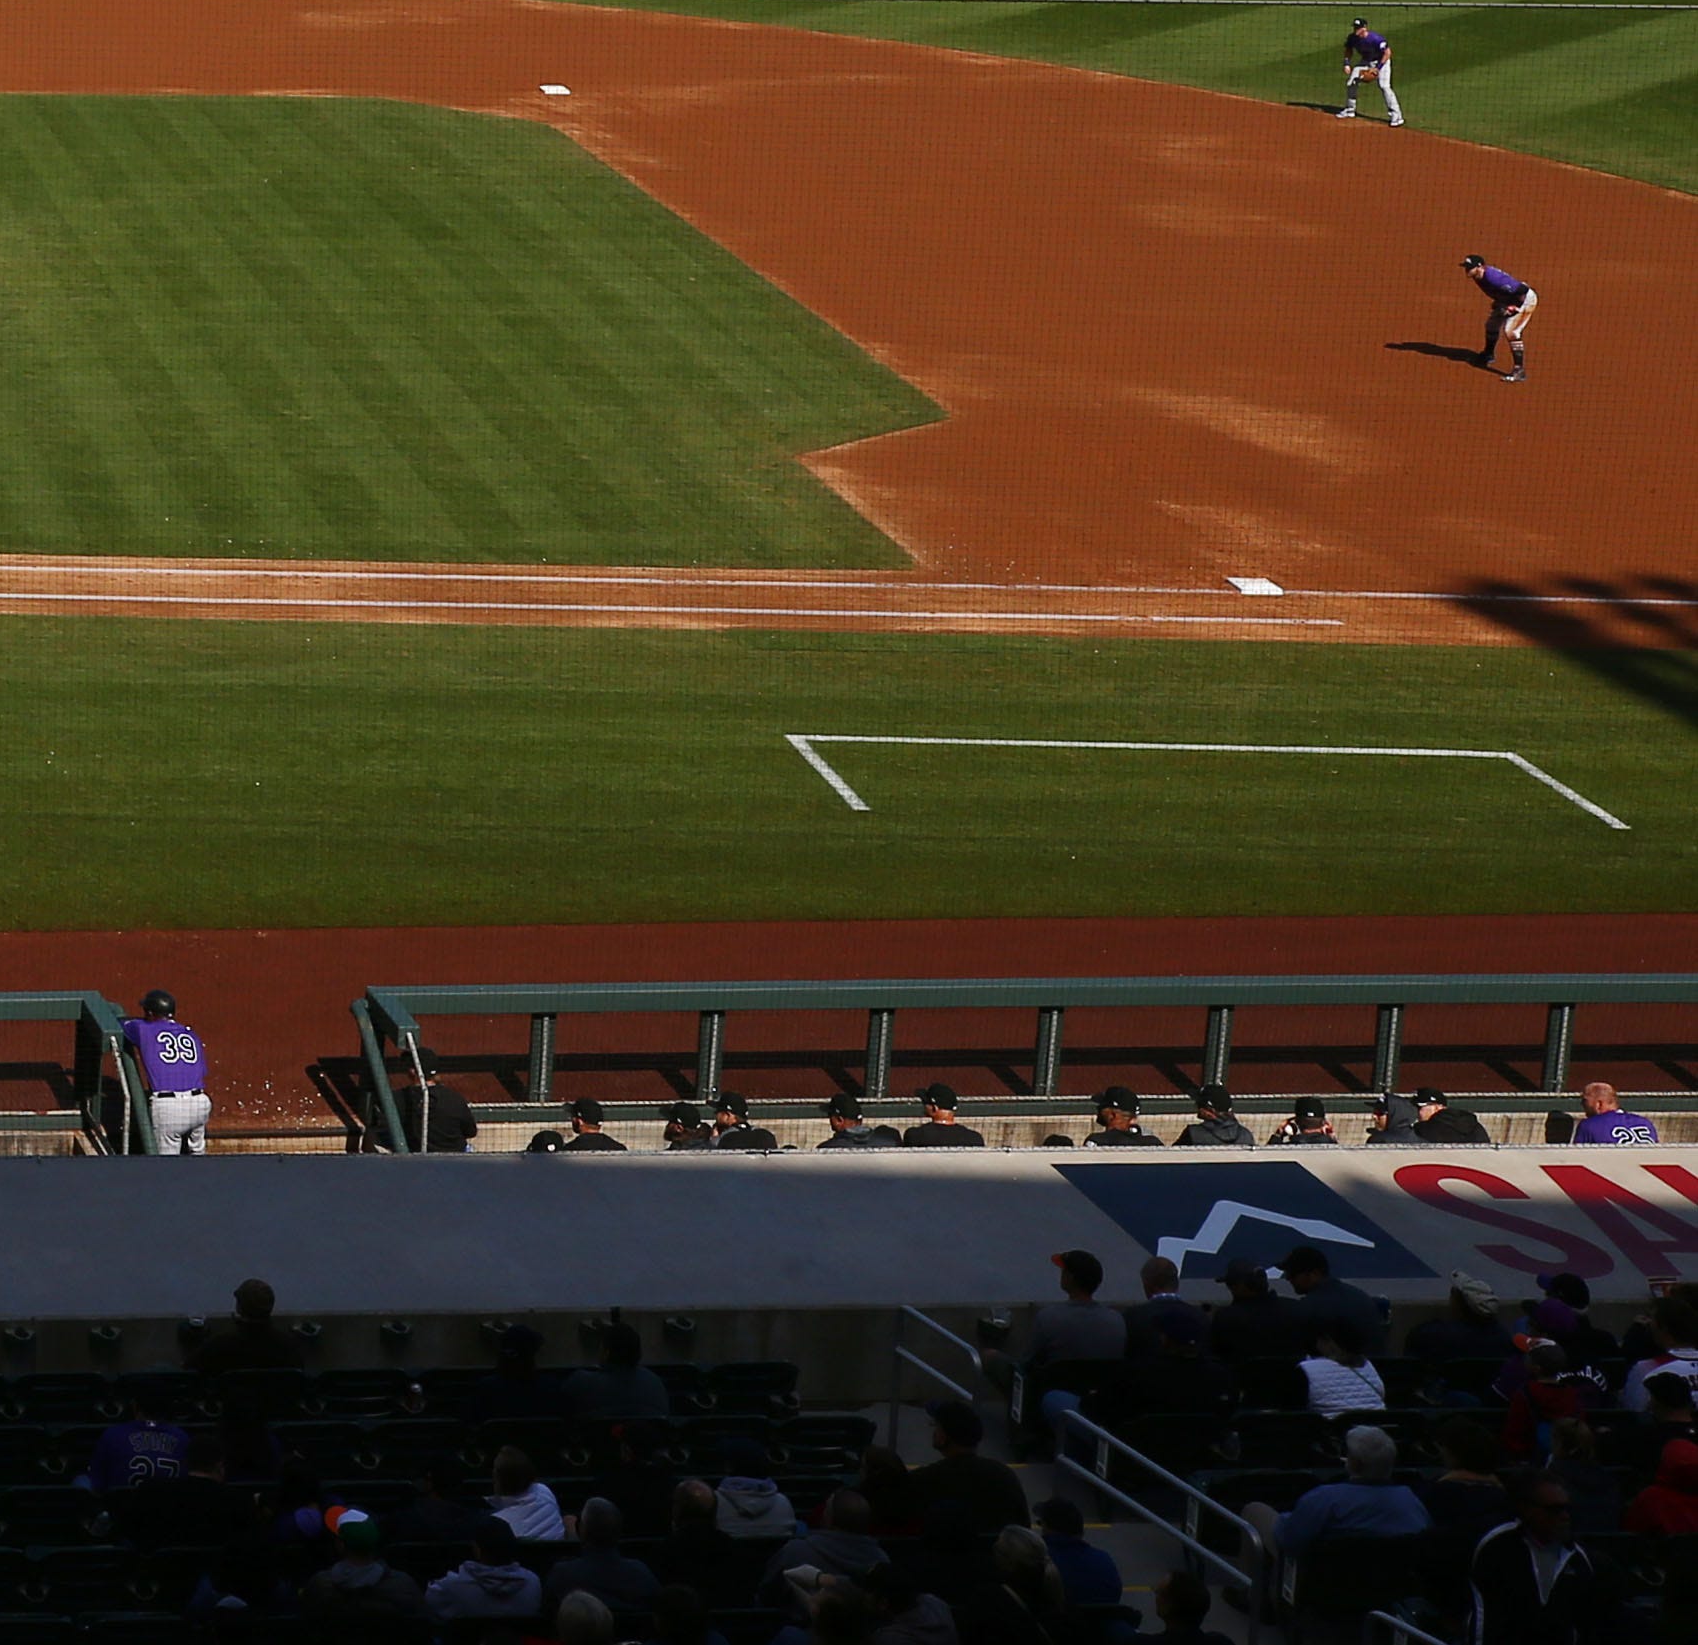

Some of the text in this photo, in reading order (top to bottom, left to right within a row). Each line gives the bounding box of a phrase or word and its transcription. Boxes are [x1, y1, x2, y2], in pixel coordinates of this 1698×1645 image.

[156, 1030, 198, 1065] 39
[1610, 1125, 1657, 1145] 25
[1393, 1164, 1698, 1279] SA
[128, 1455, 181, 1487] 27
